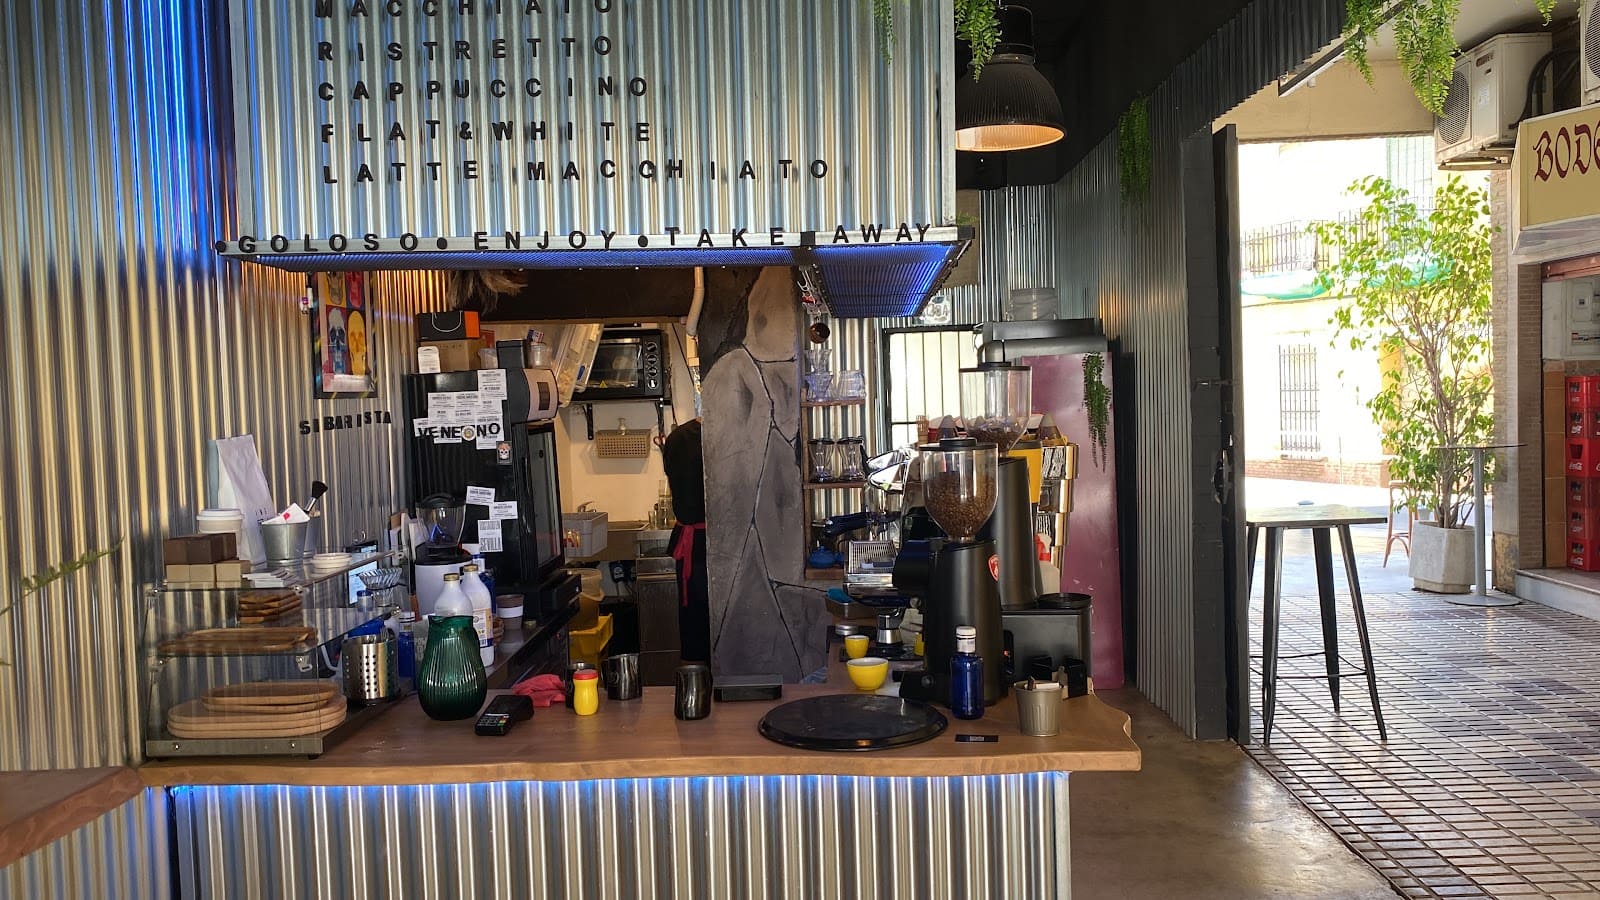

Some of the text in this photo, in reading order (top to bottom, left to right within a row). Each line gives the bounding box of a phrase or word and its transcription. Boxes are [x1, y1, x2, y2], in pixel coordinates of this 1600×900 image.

[318, 35, 612, 62] RISTRETTO
[318, 76, 648, 102] CAPPUCCINO
[324, 159, 829, 184] LATTE MACCHIATO
[238, 222, 933, 254] GOLOSO ENJOY TAKE AWAY
